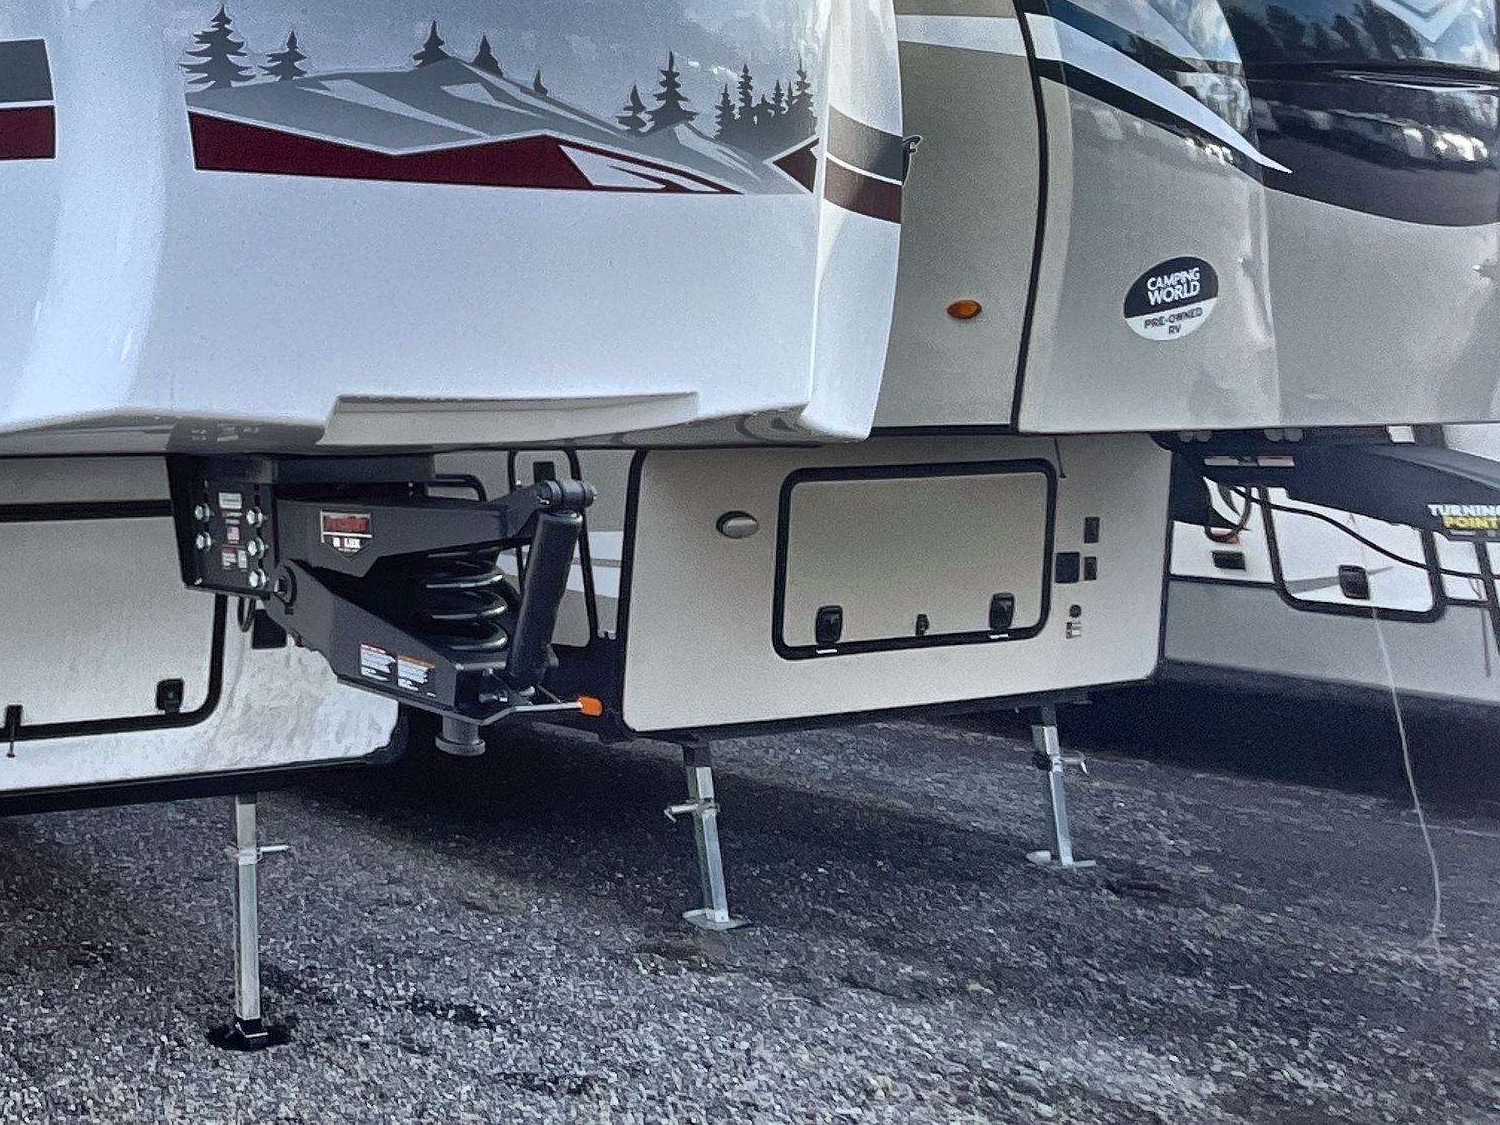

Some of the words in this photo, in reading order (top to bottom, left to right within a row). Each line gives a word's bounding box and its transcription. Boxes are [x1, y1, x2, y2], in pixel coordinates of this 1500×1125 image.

[1147, 267, 1200, 290] CAMPING
[1147, 281, 1200, 306] WORLD
[1443, 516, 1498, 529] POINT
